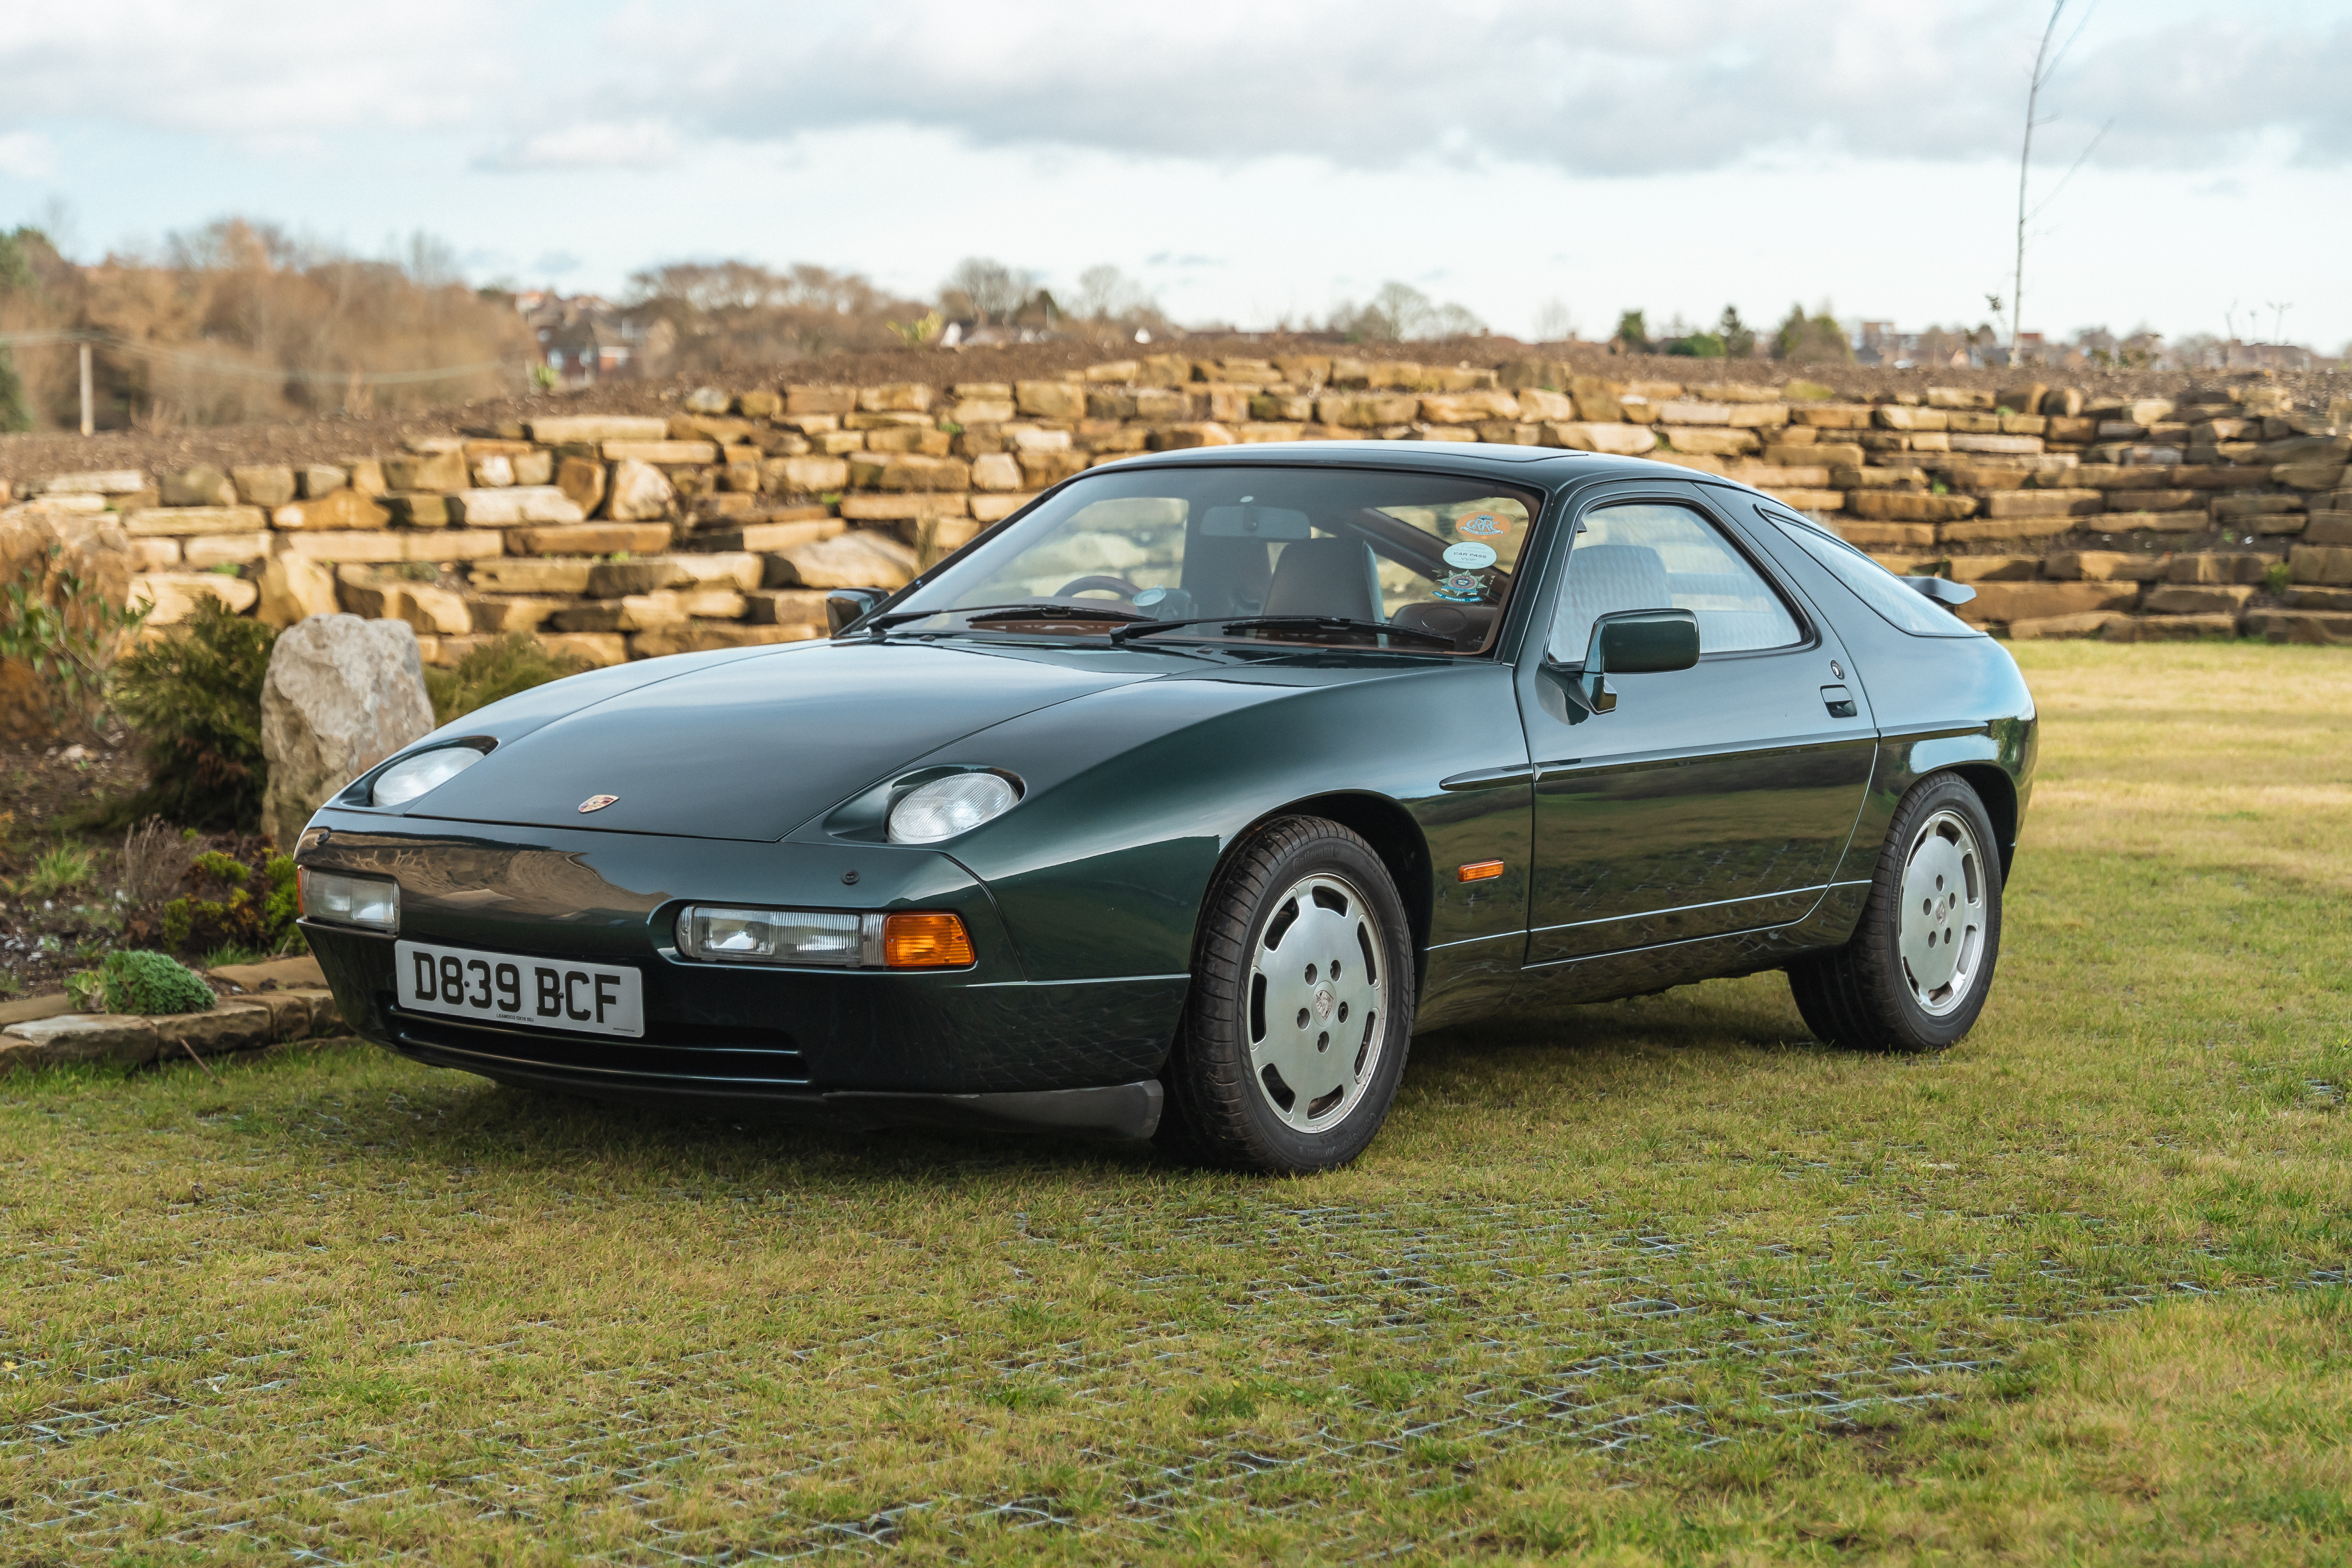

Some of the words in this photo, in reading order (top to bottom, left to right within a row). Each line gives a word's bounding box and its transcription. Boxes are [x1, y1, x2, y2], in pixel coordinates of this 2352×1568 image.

[1466, 518, 1500, 533] GRRC
[413, 951, 521, 1013] D839
[534, 967, 621, 1023] BCF
